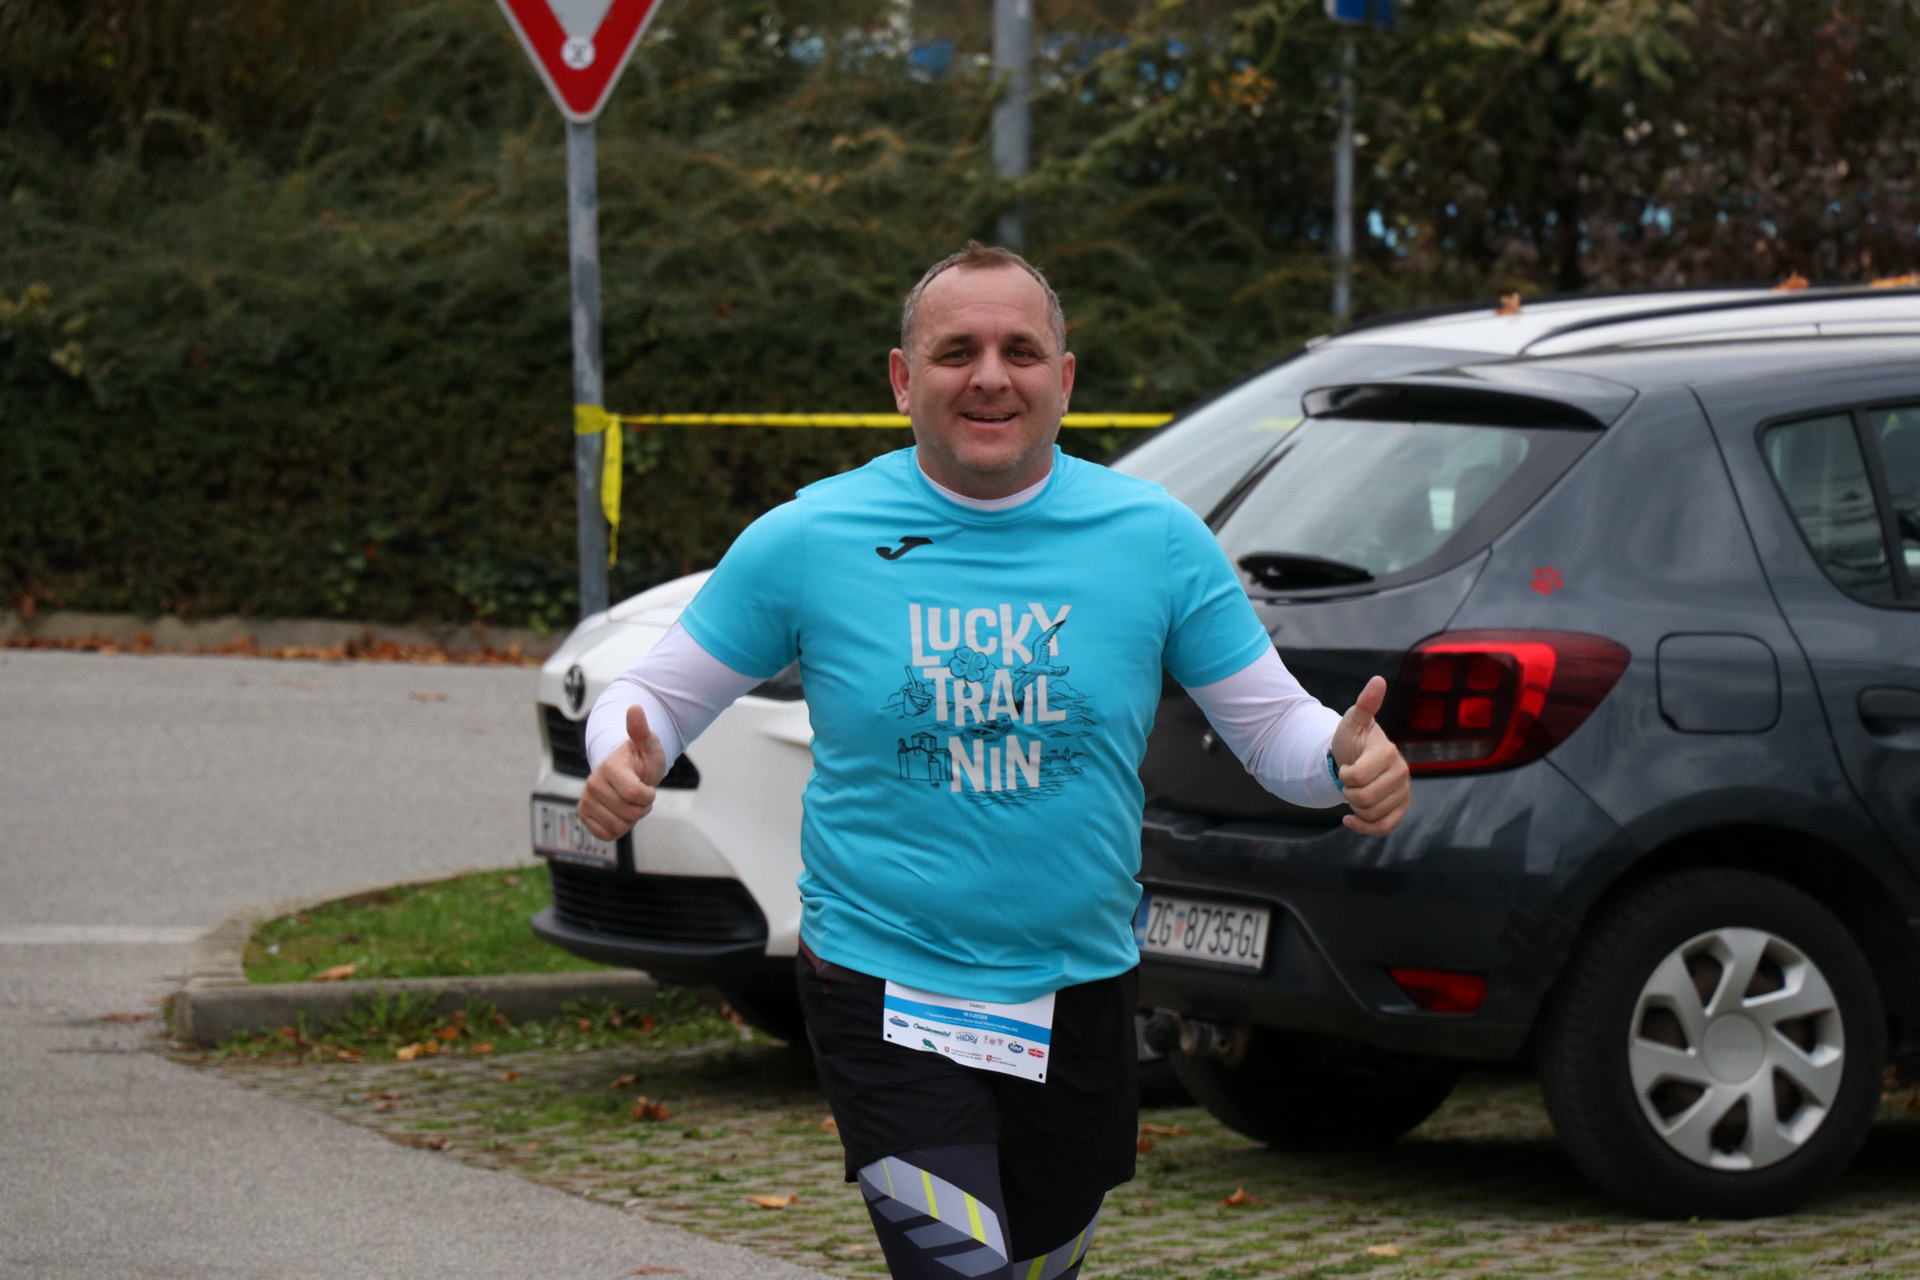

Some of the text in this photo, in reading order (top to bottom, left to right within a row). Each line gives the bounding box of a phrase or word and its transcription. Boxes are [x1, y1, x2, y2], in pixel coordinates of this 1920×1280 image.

[908, 602, 1073, 667] LUCKY
[922, 667, 1067, 727] TRAIL
[948, 734, 1042, 793] NIN
[1147, 901, 1174, 946] ZG
